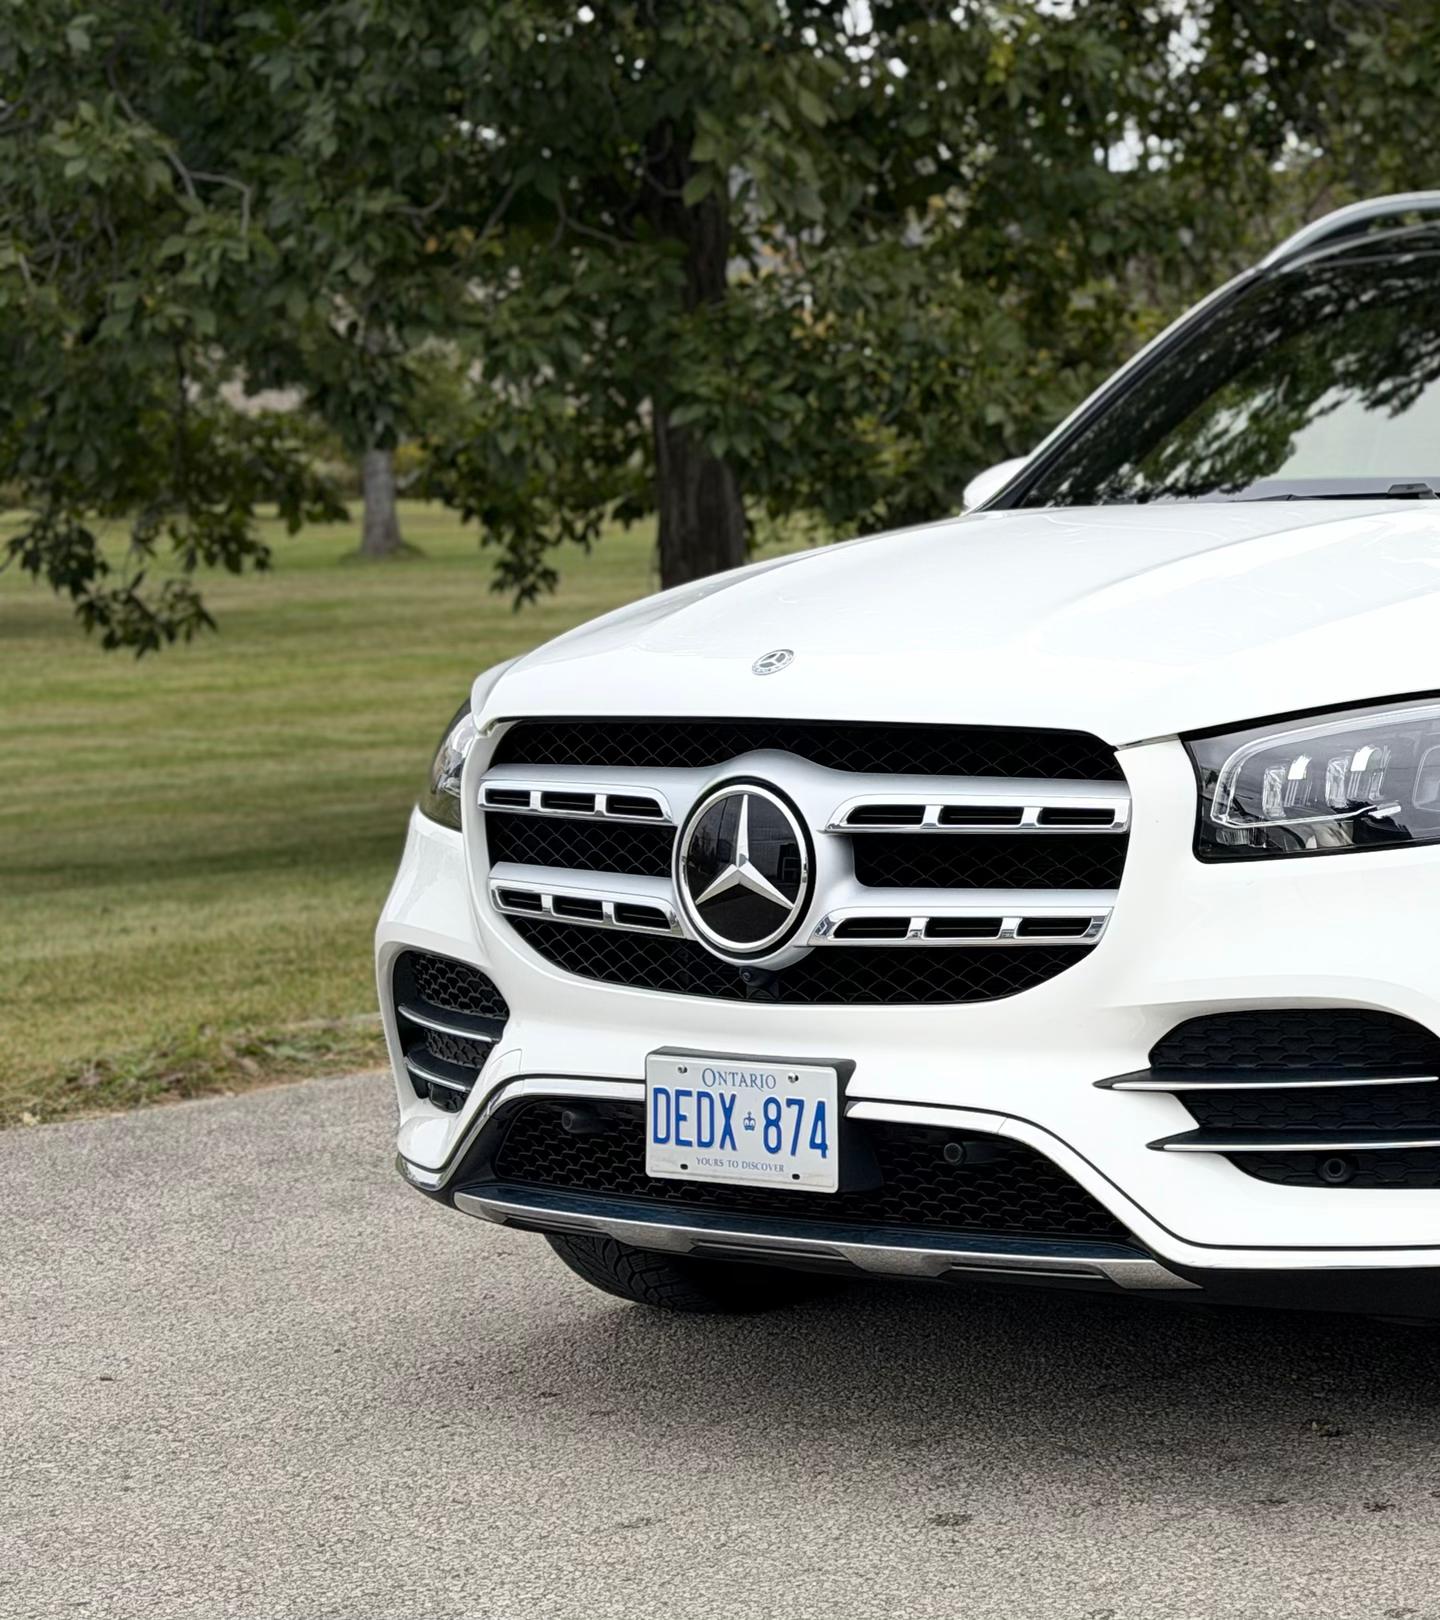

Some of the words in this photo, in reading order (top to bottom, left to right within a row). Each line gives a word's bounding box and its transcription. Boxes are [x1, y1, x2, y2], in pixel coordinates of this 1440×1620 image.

[702, 1067, 777, 1092] ONTARIO
[653, 1087, 737, 1151] DEDX
[763, 1096, 828, 1159] 874
[696, 1157, 724, 1168] YOURS
[726, 1159, 739, 1168] TO
[741, 1160, 785, 1173] DISCOVER
